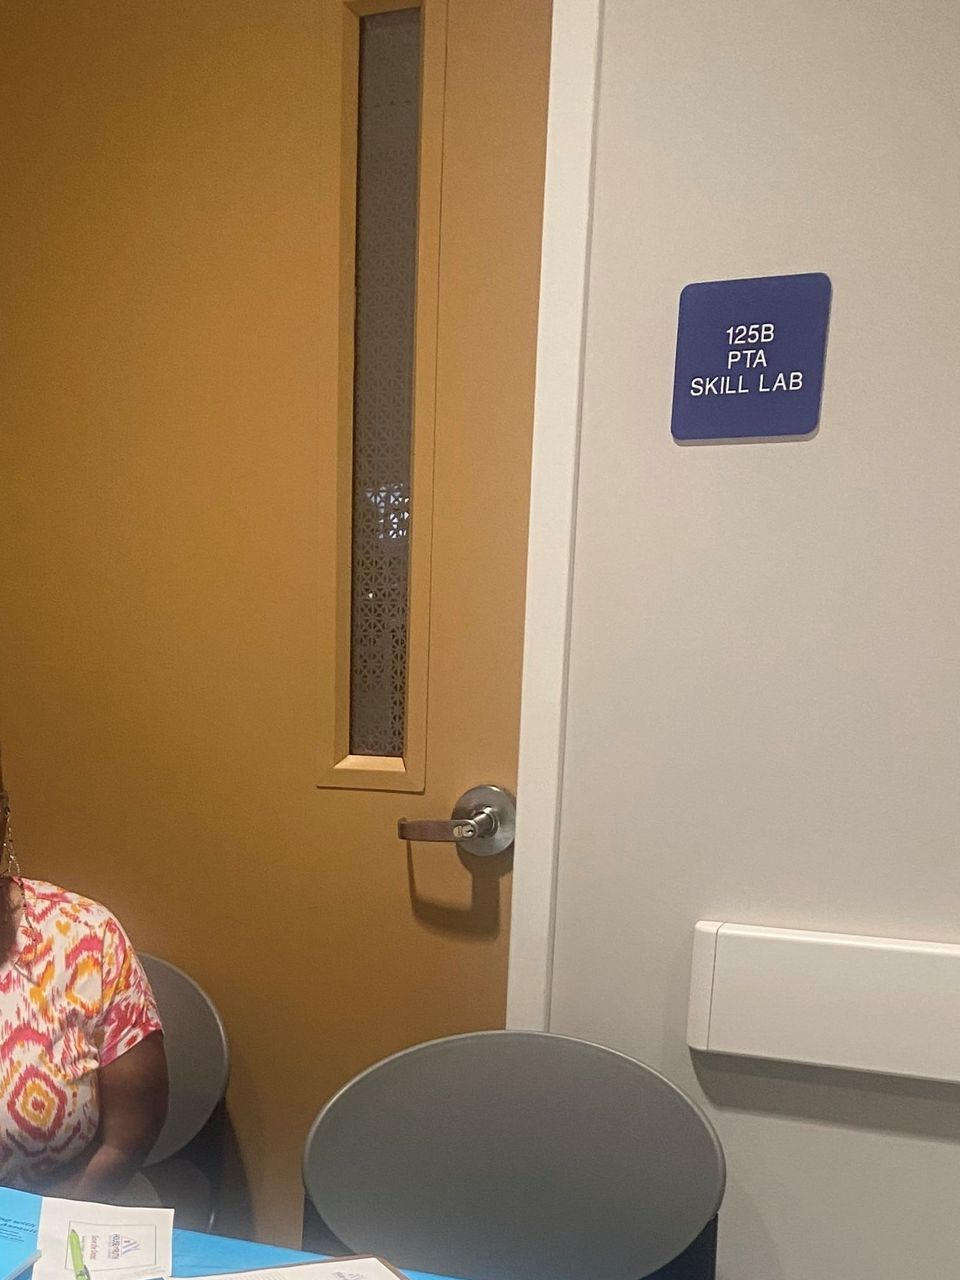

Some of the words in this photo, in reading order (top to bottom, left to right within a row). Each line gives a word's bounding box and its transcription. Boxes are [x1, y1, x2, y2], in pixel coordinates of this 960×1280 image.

[726, 323, 775, 345] 125B
[727, 349, 767, 369] PTA
[690, 375, 749, 396] SKILL
[759, 371, 803, 392] LAB
